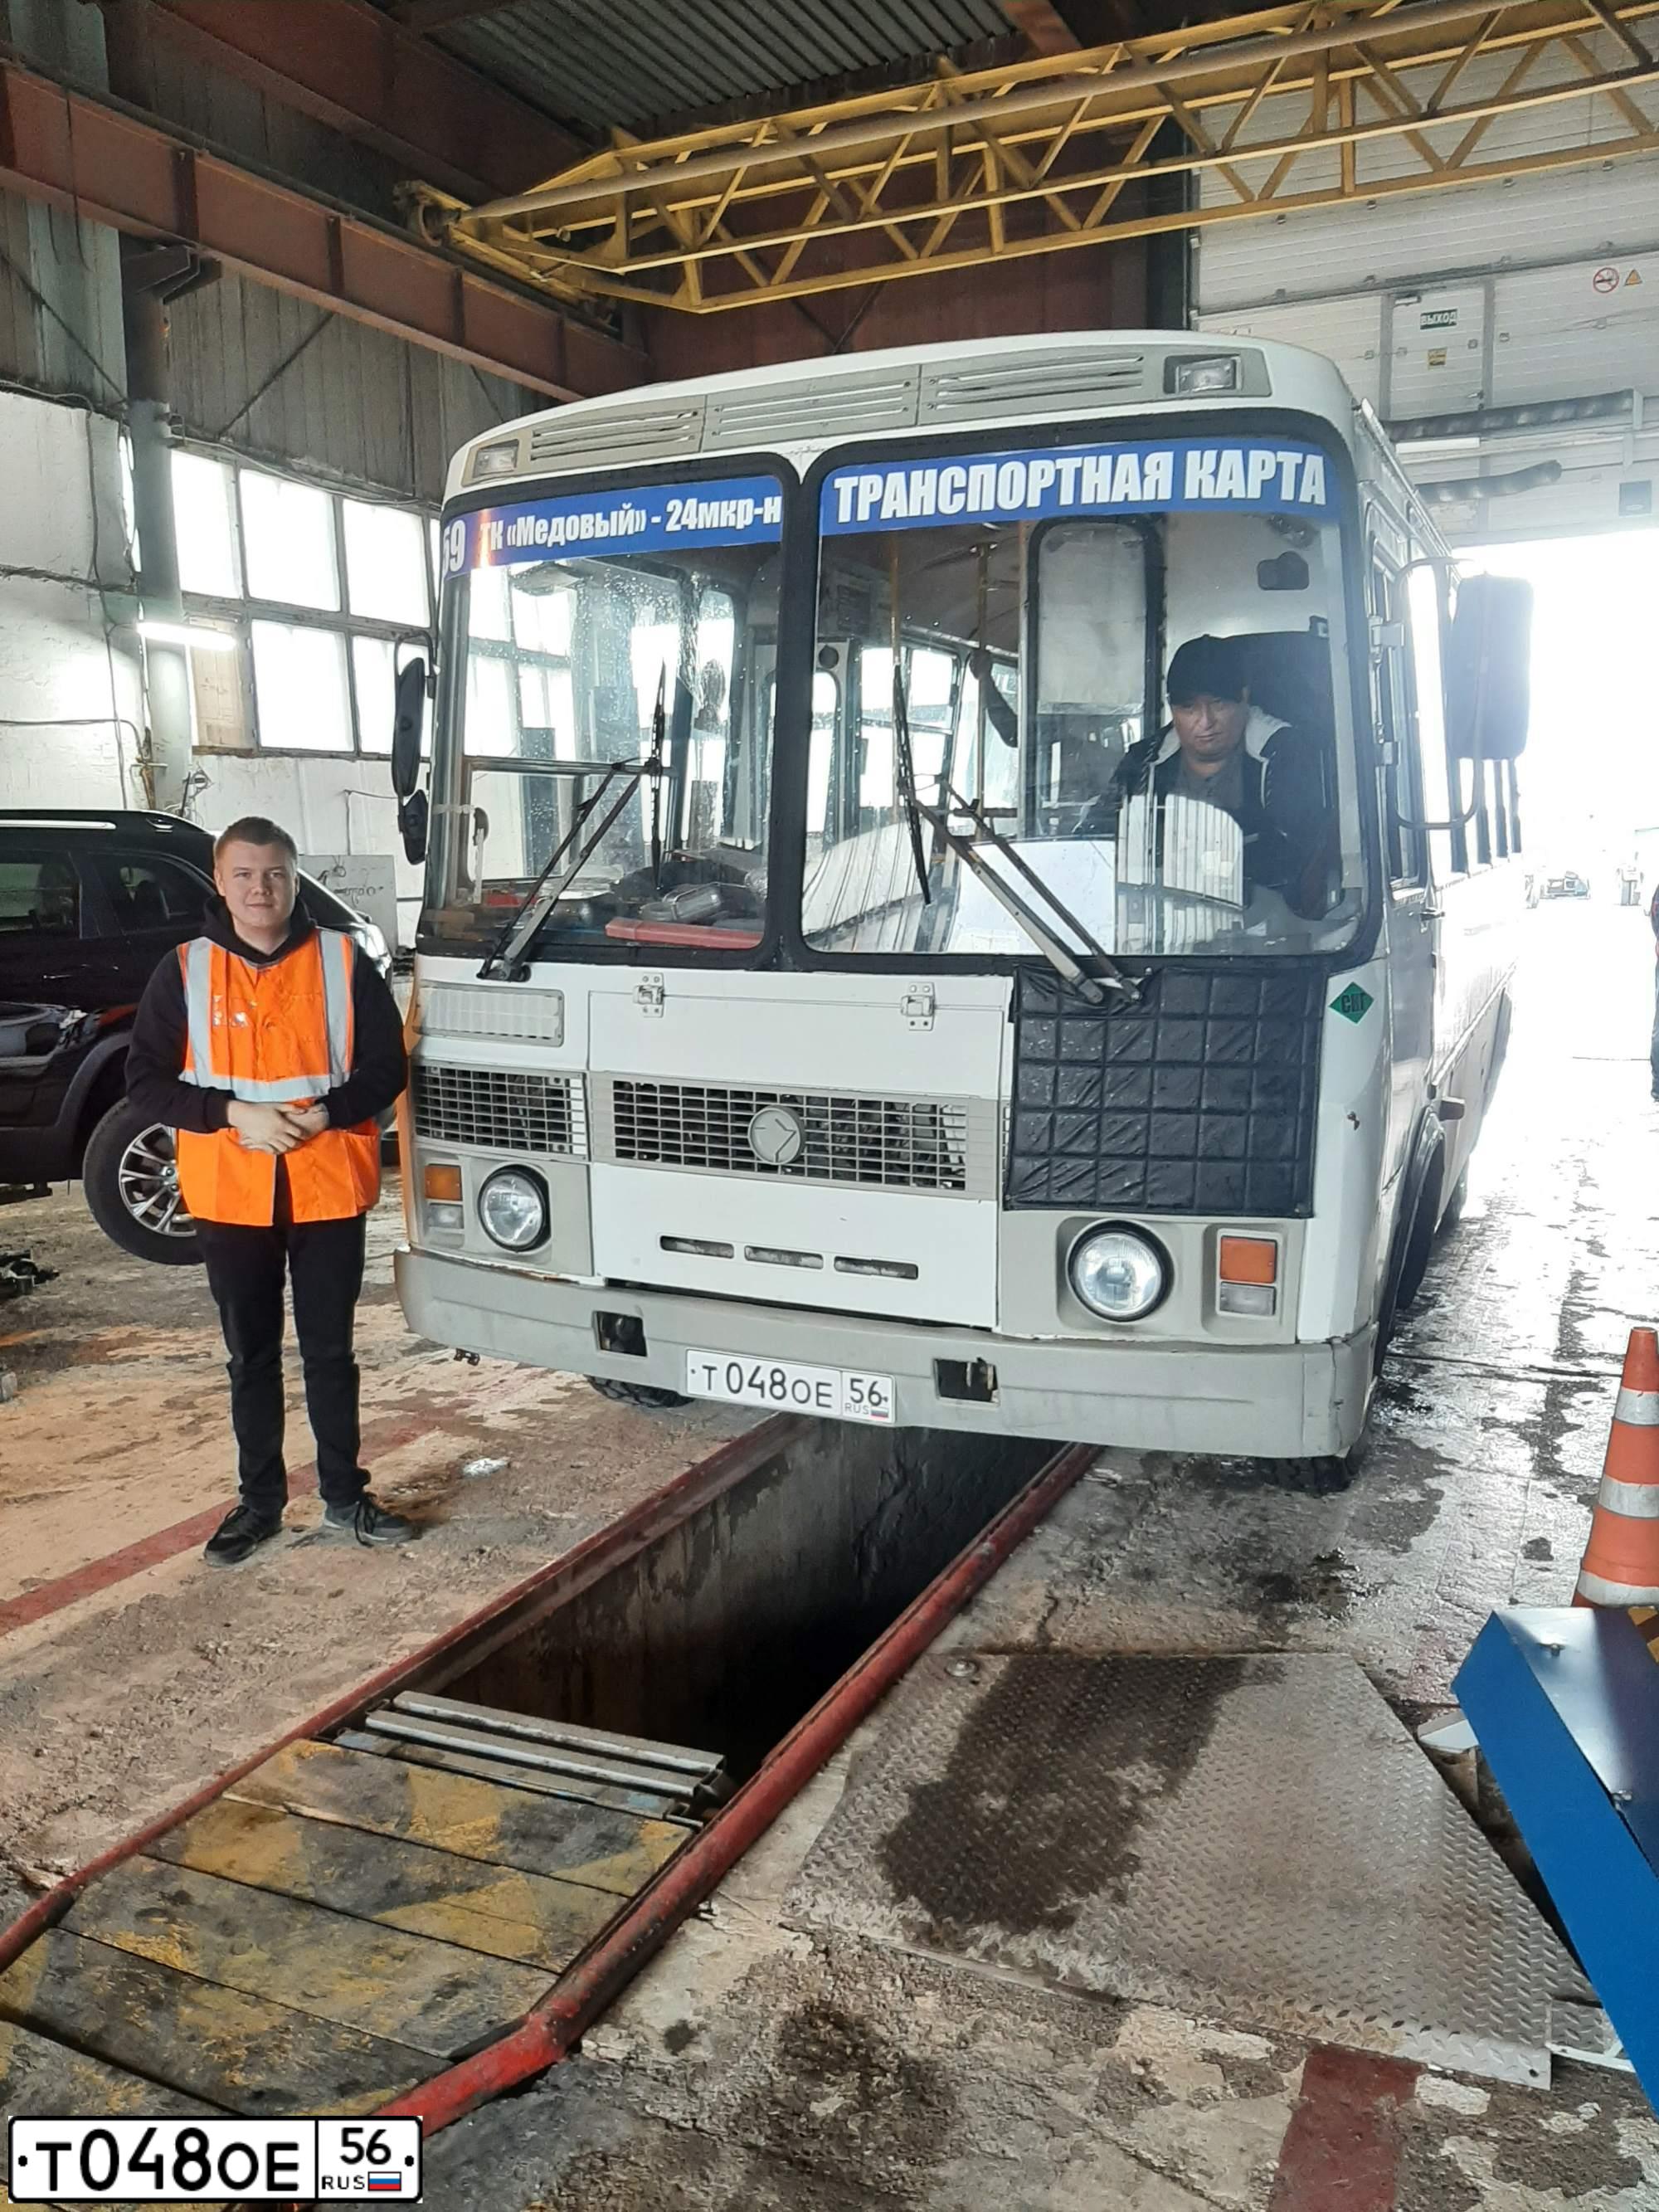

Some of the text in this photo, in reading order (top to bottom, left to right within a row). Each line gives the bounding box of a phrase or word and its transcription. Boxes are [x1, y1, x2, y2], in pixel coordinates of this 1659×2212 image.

[1420, 311, 1457, 325] ВЫХОД
[834, 450, 1326, 524] ТРАНСПОРТНАЯ КАРТА
[480, 520, 504, 553] ТК
[665, 496, 782, 532] 24мкр-н
[702, 1362, 883, 1409] Т048ОЕ 56
[844, 1403, 870, 1415] RUS
